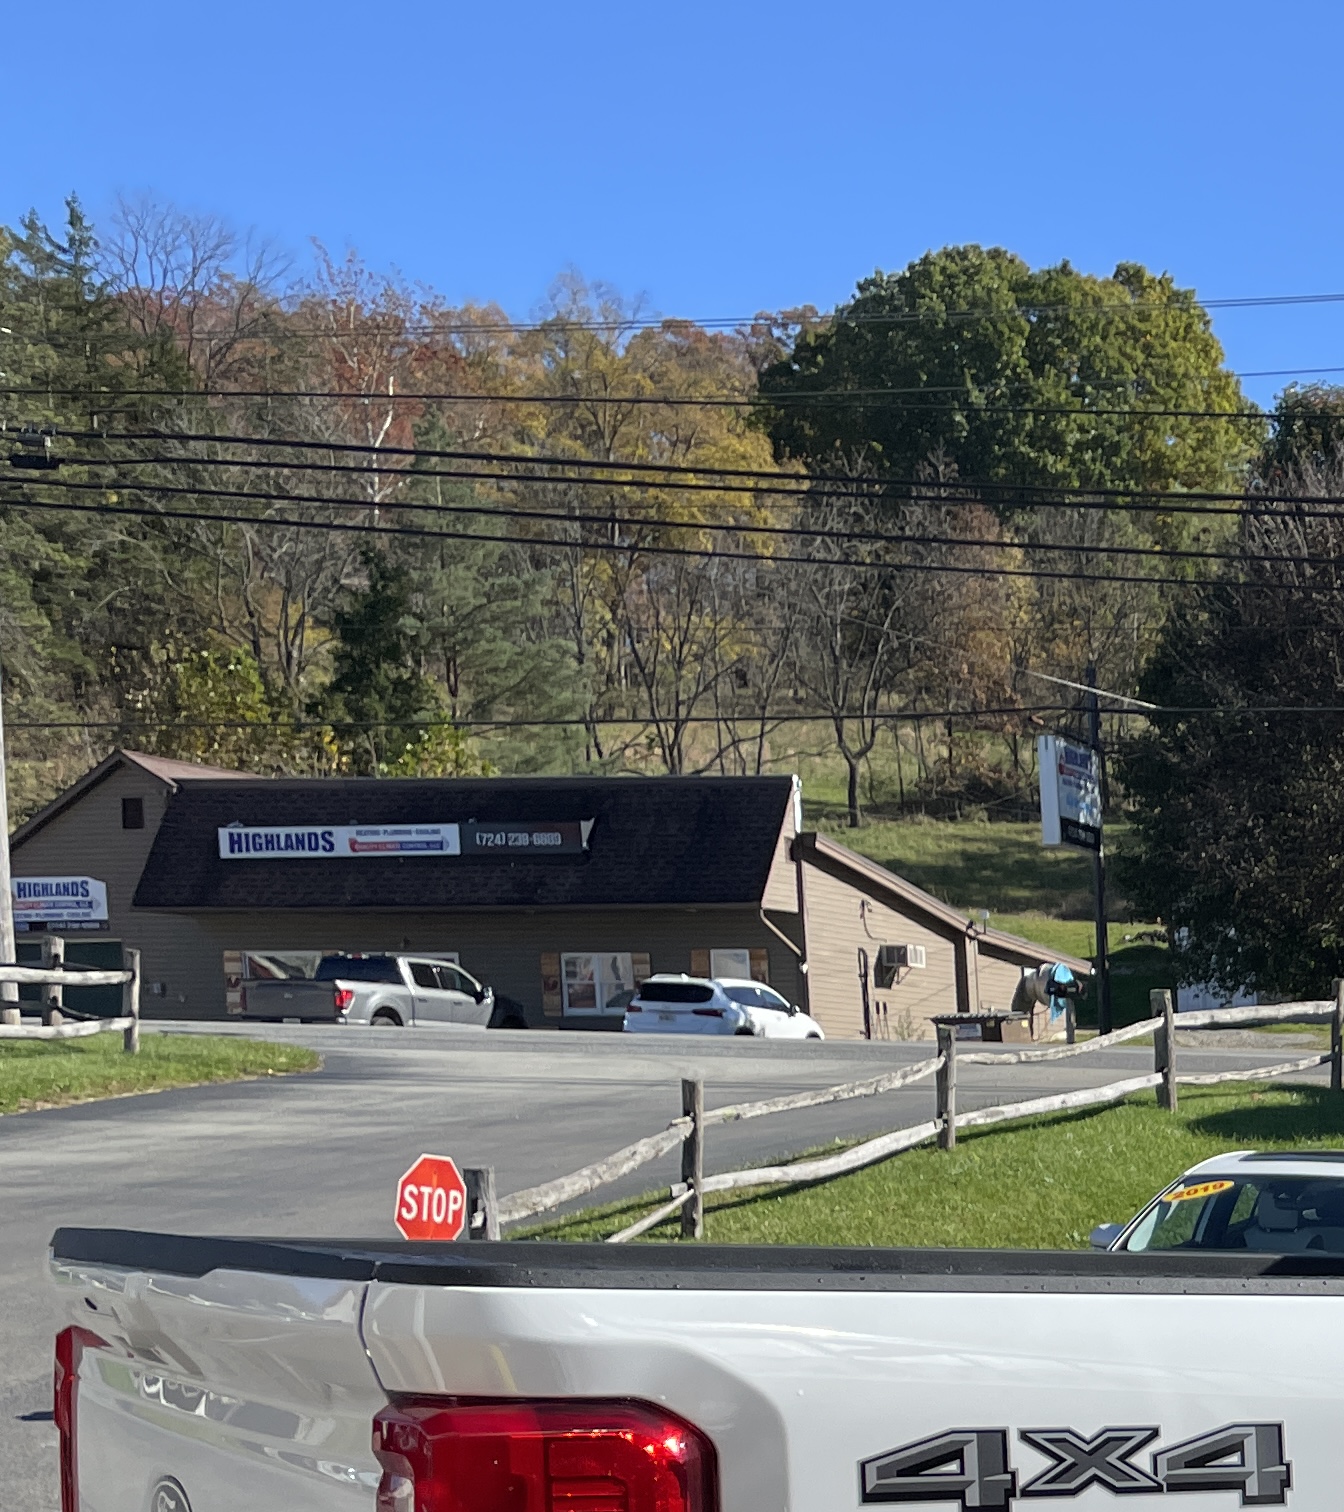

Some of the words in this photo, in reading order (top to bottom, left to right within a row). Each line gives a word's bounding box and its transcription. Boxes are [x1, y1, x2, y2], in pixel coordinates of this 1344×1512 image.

[228, 830, 335, 854] HIGHLANDS
[16, 880, 90, 899] HIGHLANDS
[1172, 1182, 1225, 1200] 2019
[401, 1184, 462, 1225] STOP
